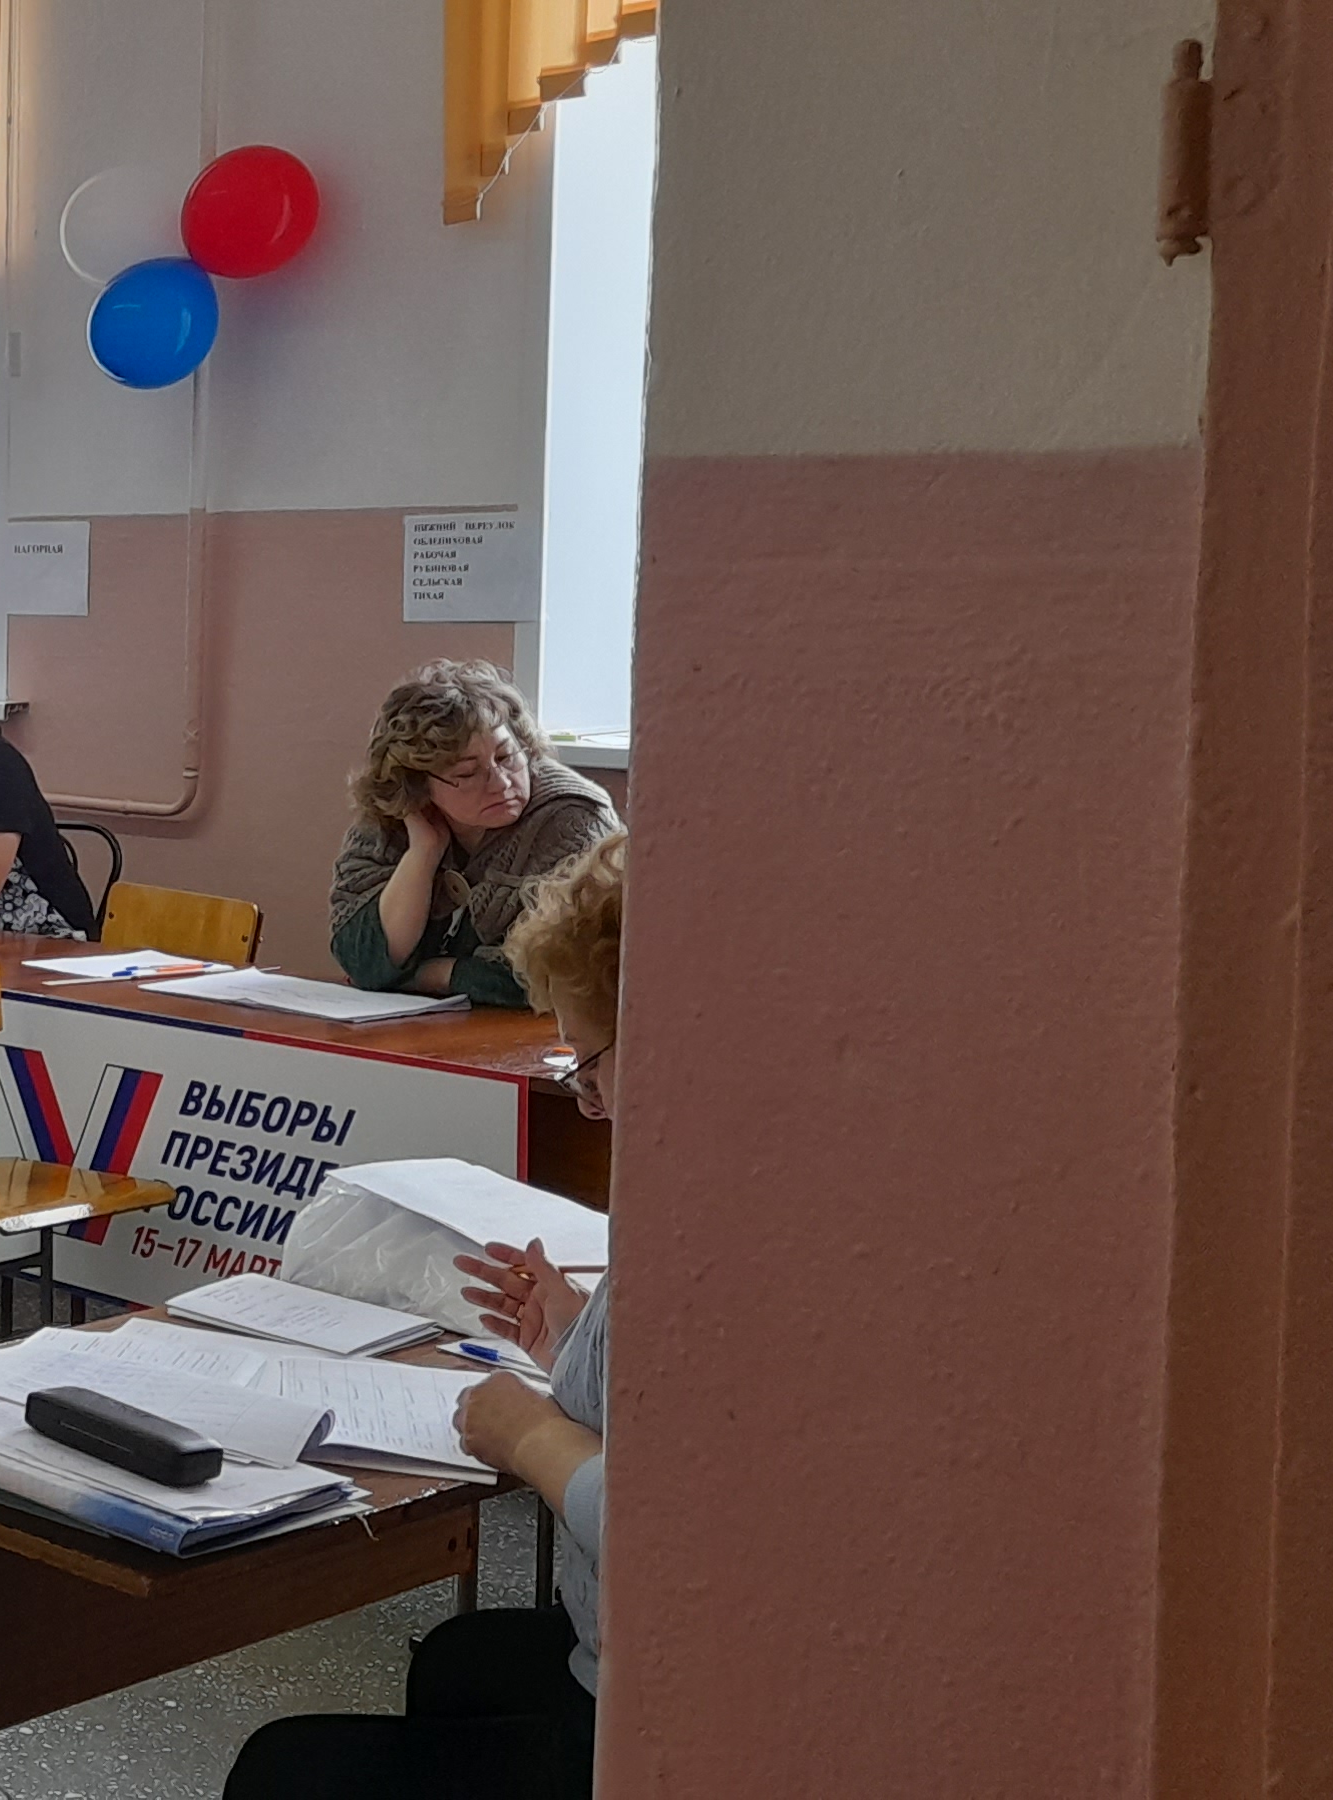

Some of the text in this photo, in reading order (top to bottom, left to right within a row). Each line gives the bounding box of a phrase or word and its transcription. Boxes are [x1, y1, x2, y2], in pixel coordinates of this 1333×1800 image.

[465, 521, 515, 531] ПЕРЕУЛОК
[413, 536, 483, 546] ОБЛЕПИХОВАЯ
[14, 544, 63, 554] НАГОРНАЯ
[413, 550, 456, 560] РАБОЧАЯ
[413, 563, 469, 573] РУБИНОВАЯ
[413, 577, 462, 587] СЕЛЬСКАЯ
[413, 591, 444, 600] ТИХАЯ
[179, 1080, 356, 1146] ВЫБОРЫ
[161, 1130, 340, 1201] ПРЕЗИДЕ
[167, 1185, 297, 1245] ОССИИ
[203, 1244, 282, 1280] МАРТ
